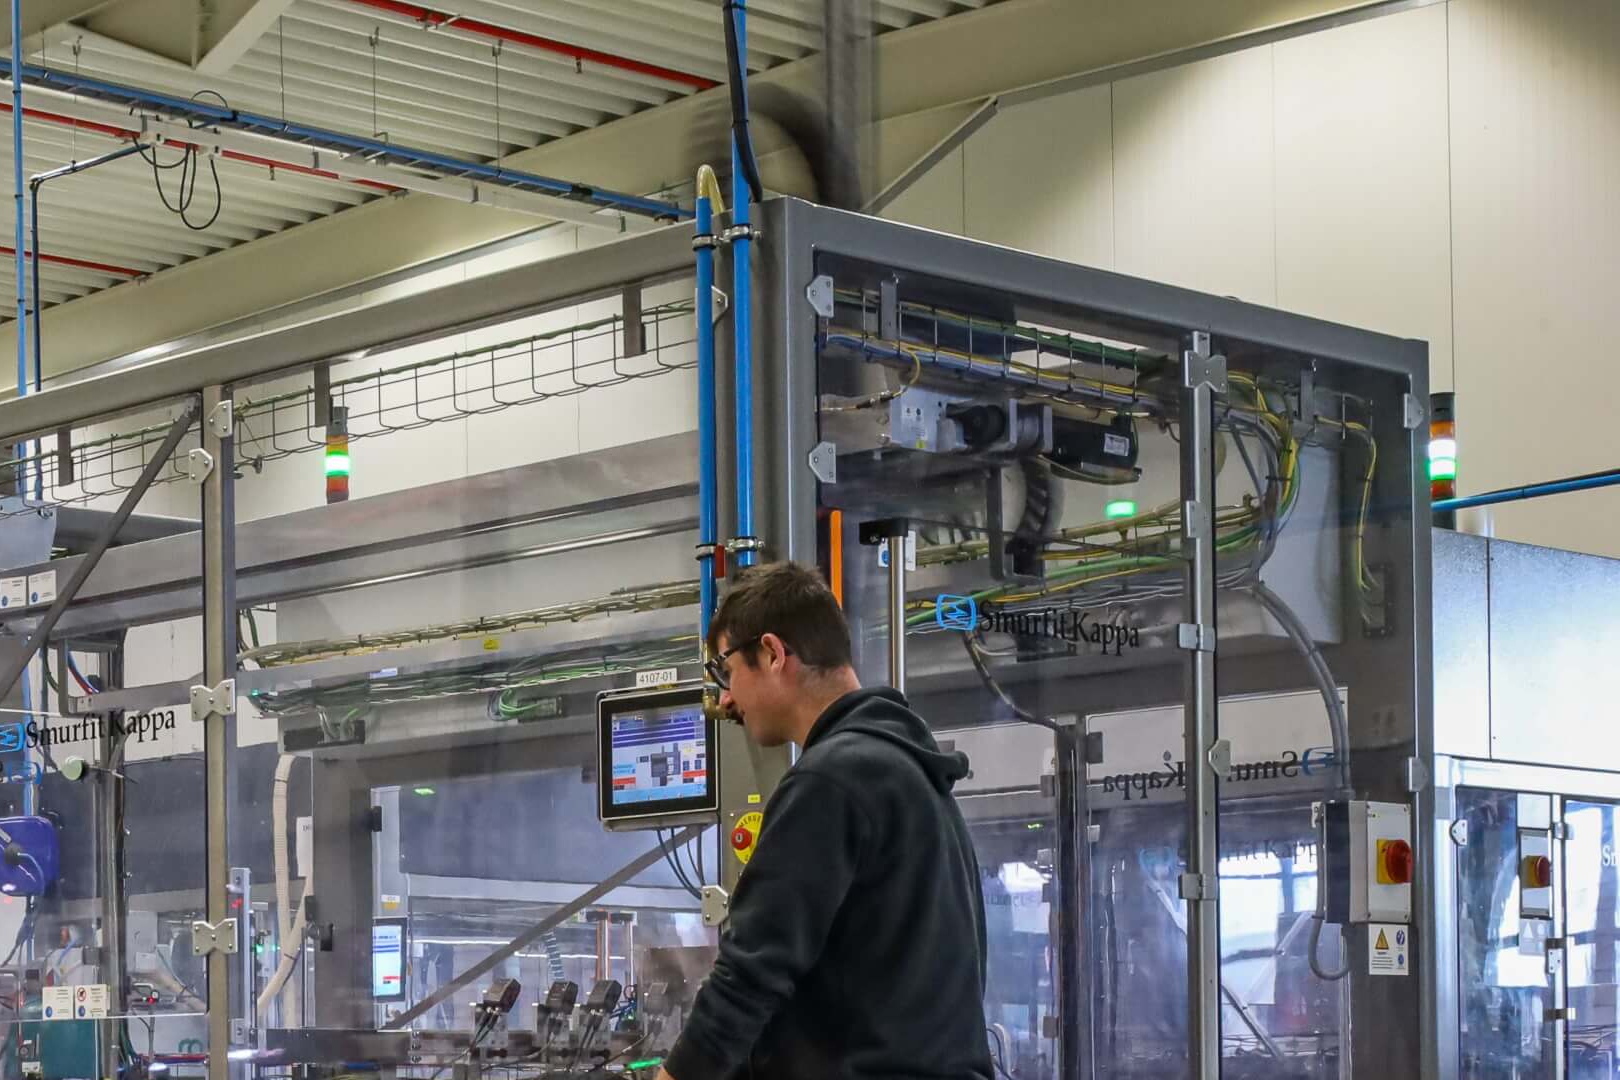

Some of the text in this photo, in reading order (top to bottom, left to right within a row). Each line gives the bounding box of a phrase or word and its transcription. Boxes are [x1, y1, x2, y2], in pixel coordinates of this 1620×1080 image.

[980, 601, 1140, 656] Smurfit Kappa
[639, 671, 672, 683] 4107-01
[26, 708, 176, 749] Smurfit Kappa
